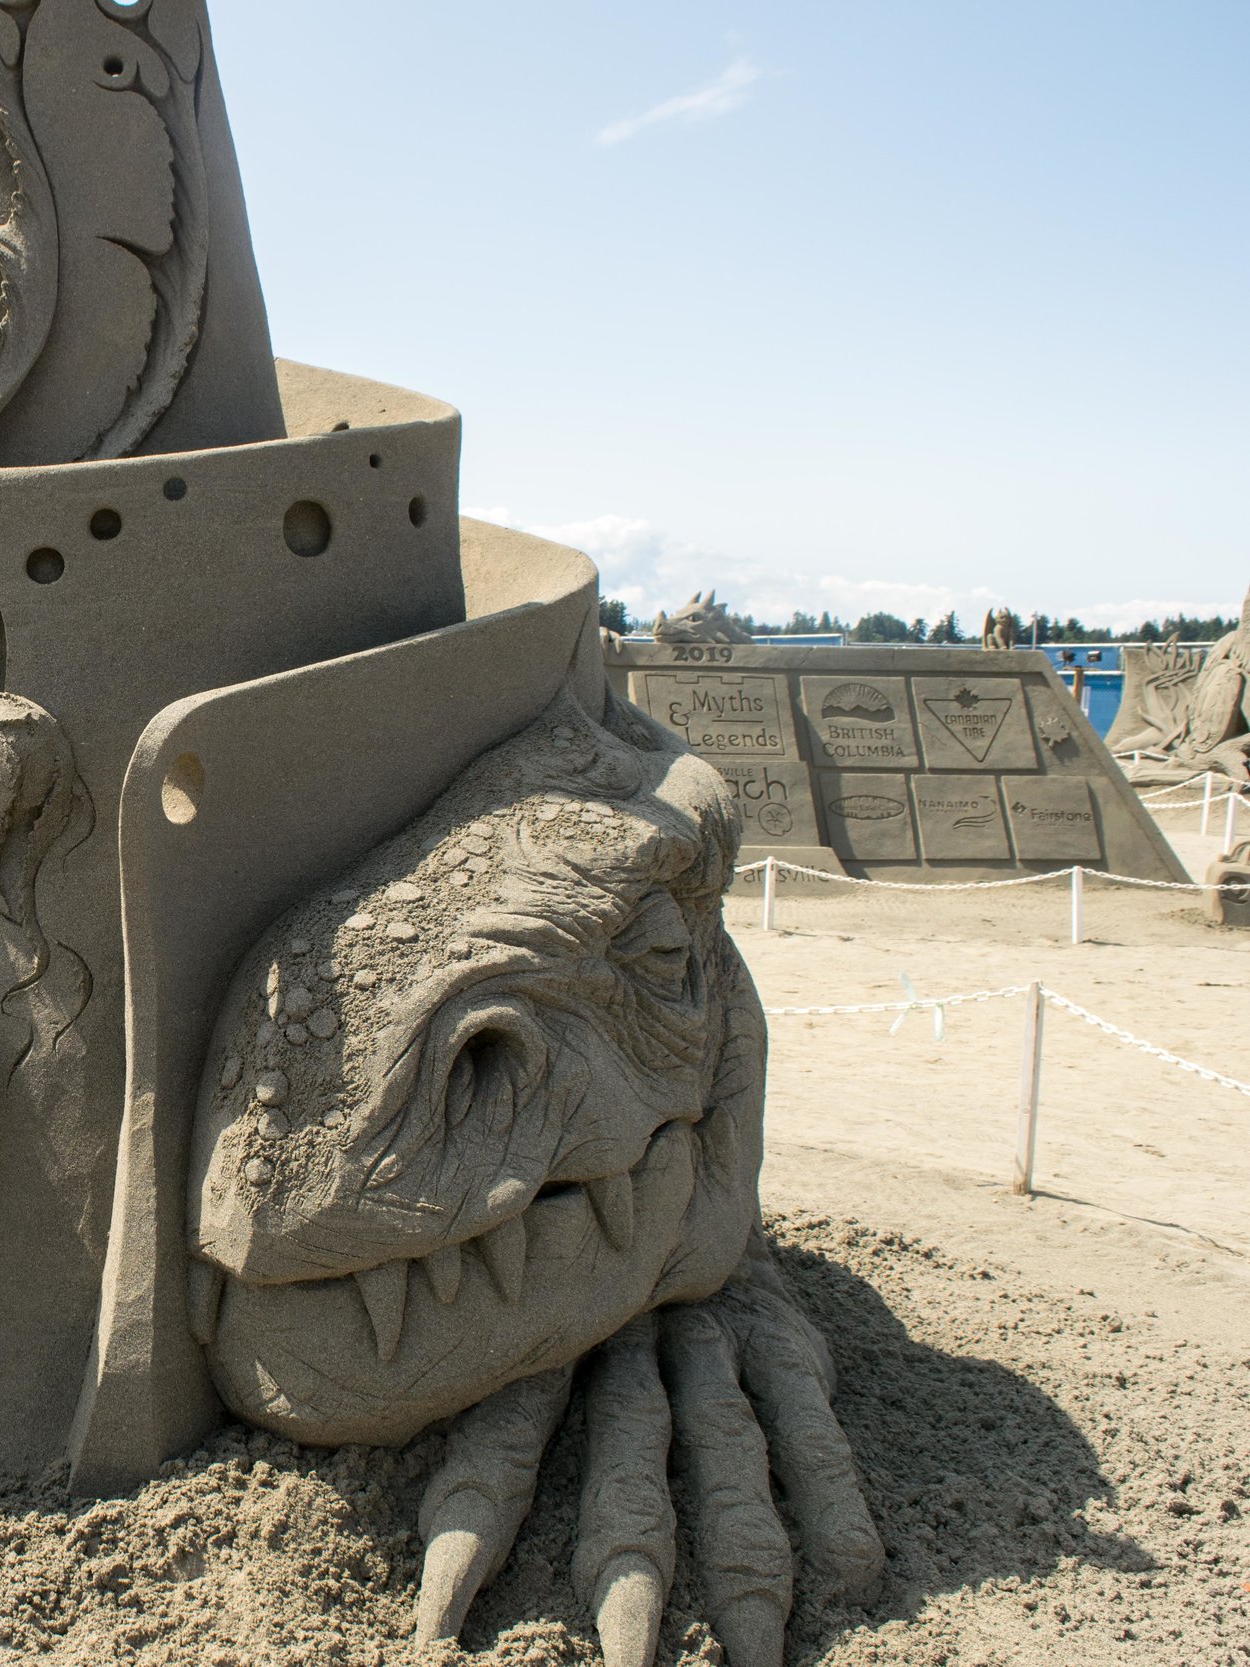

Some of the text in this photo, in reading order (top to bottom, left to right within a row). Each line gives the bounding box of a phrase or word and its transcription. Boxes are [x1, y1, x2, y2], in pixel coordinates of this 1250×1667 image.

[672, 646, 733, 663] 2019
[692, 689, 764, 718] Myths
[669, 702, 692, 727] &
[944, 714, 997, 725] CANADIAN
[685, 727, 779, 751] Legends
[828, 725, 896, 740] BRITISH
[962, 727, 986, 738] TIRE
[822, 742, 907, 758] COLUMBIA
[717, 767, 754, 777] SVILLE
[725, 767, 788, 800] ach
[918, 799, 979, 809] NANAIMO
[1030, 808, 1092, 821] Fairstone
[734, 864, 830, 884] arsville
